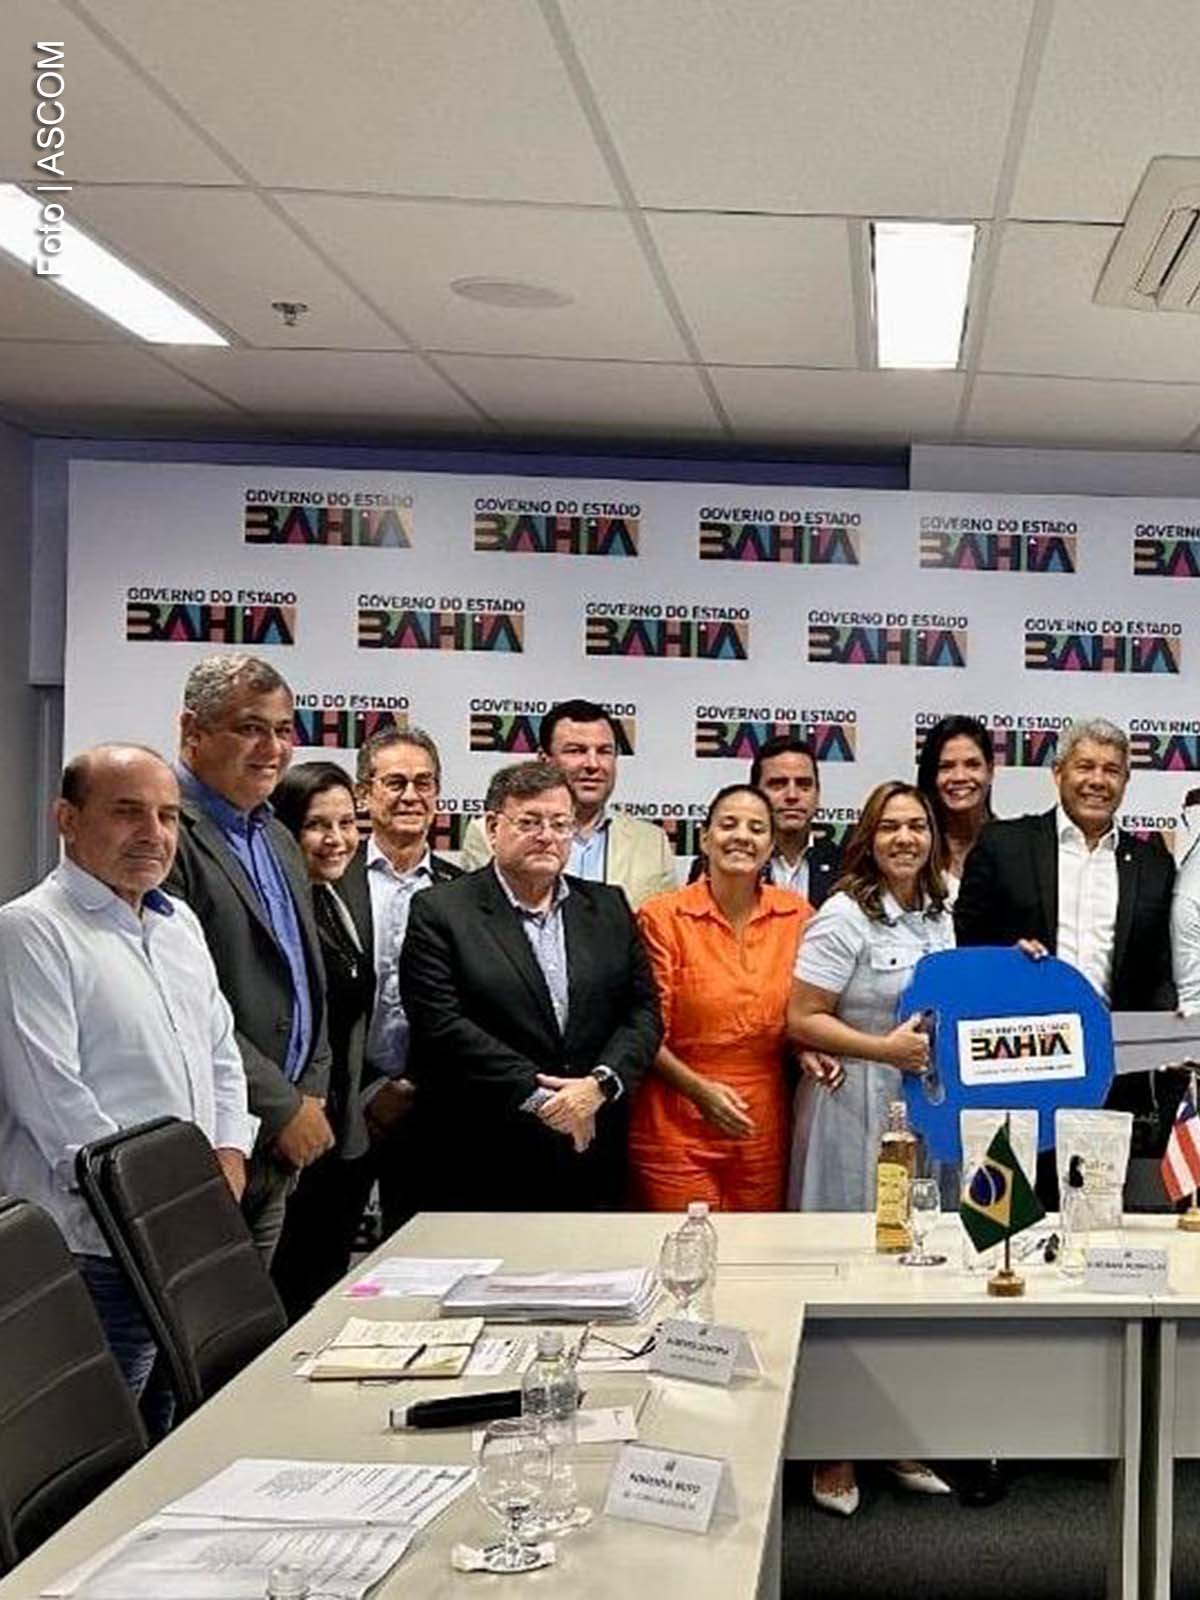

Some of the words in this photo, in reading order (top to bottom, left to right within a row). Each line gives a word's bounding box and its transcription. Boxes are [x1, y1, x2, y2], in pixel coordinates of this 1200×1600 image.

[246, 490, 322, 504] GOVERNO
[328, 492, 349, 505] DO
[354, 493, 413, 507] ESTADO
[474, 499, 550, 513] GOVERNO
[555, 501, 576, 514] DO
[581, 502, 640, 516] ESTADO
[700, 508, 773, 522] GOVERNO
[778, 511, 799, 523] DO
[804, 512, 861, 526] ESTADO
[920, 517, 991, 532] GOVERNO
[996, 520, 1016, 532] DO
[1021, 521, 1077, 534] ESTADO
[246, 506, 412, 548] BAHIA
[474, 515, 639, 556] BAHIA
[700, 522, 860, 564] BAHIA
[919, 533, 1076, 573] BAHIA
[128, 588, 204, 602] GOVERNO
[210, 590, 231, 602] DO
[236, 591, 296, 604] ESTADO
[358, 595, 434, 609] GOVERNO
[439, 597, 460, 610] DO
[466, 598, 524, 612] ESTADO
[586, 603, 660, 617] GOVERNO
[665, 605, 686, 618] DO
[691, 606, 749, 620] ESTADO
[808, 610, 881, 625] GOVERNO
[886, 613, 906, 626] DO
[911, 614, 968, 628] ESTADO
[127, 602, 296, 644] BAHIA
[358, 610, 524, 652] BAHIA
[1026, 619, 1096, 633] GOVERNO
[1101, 621, 1121, 634] DO
[1126, 622, 1181, 636] ESTADO
[585, 617, 748, 660] BAHIA
[808, 627, 967, 668] BAHIA
[1025, 634, 1180, 673] BAHIA
[323, 695, 345, 708] DO
[351, 696, 409, 710] ESTADO
[470, 700, 545, 714] GOVERNO
[697, 706, 770, 721] GOVERNO
[775, 709, 795, 721] DO
[800, 709, 856, 723] ESTADO
[993, 715, 1012, 728] DO
[1018, 716, 1072, 730] ESTADO
[1130, 720, 1200, 733] GOVERNO
[436, 799, 458, 811] DO
[662, 804, 680, 816] DO
[1122, 816, 1177, 830] ESTADO
[971, 1032, 1070, 1061] BAHIA
